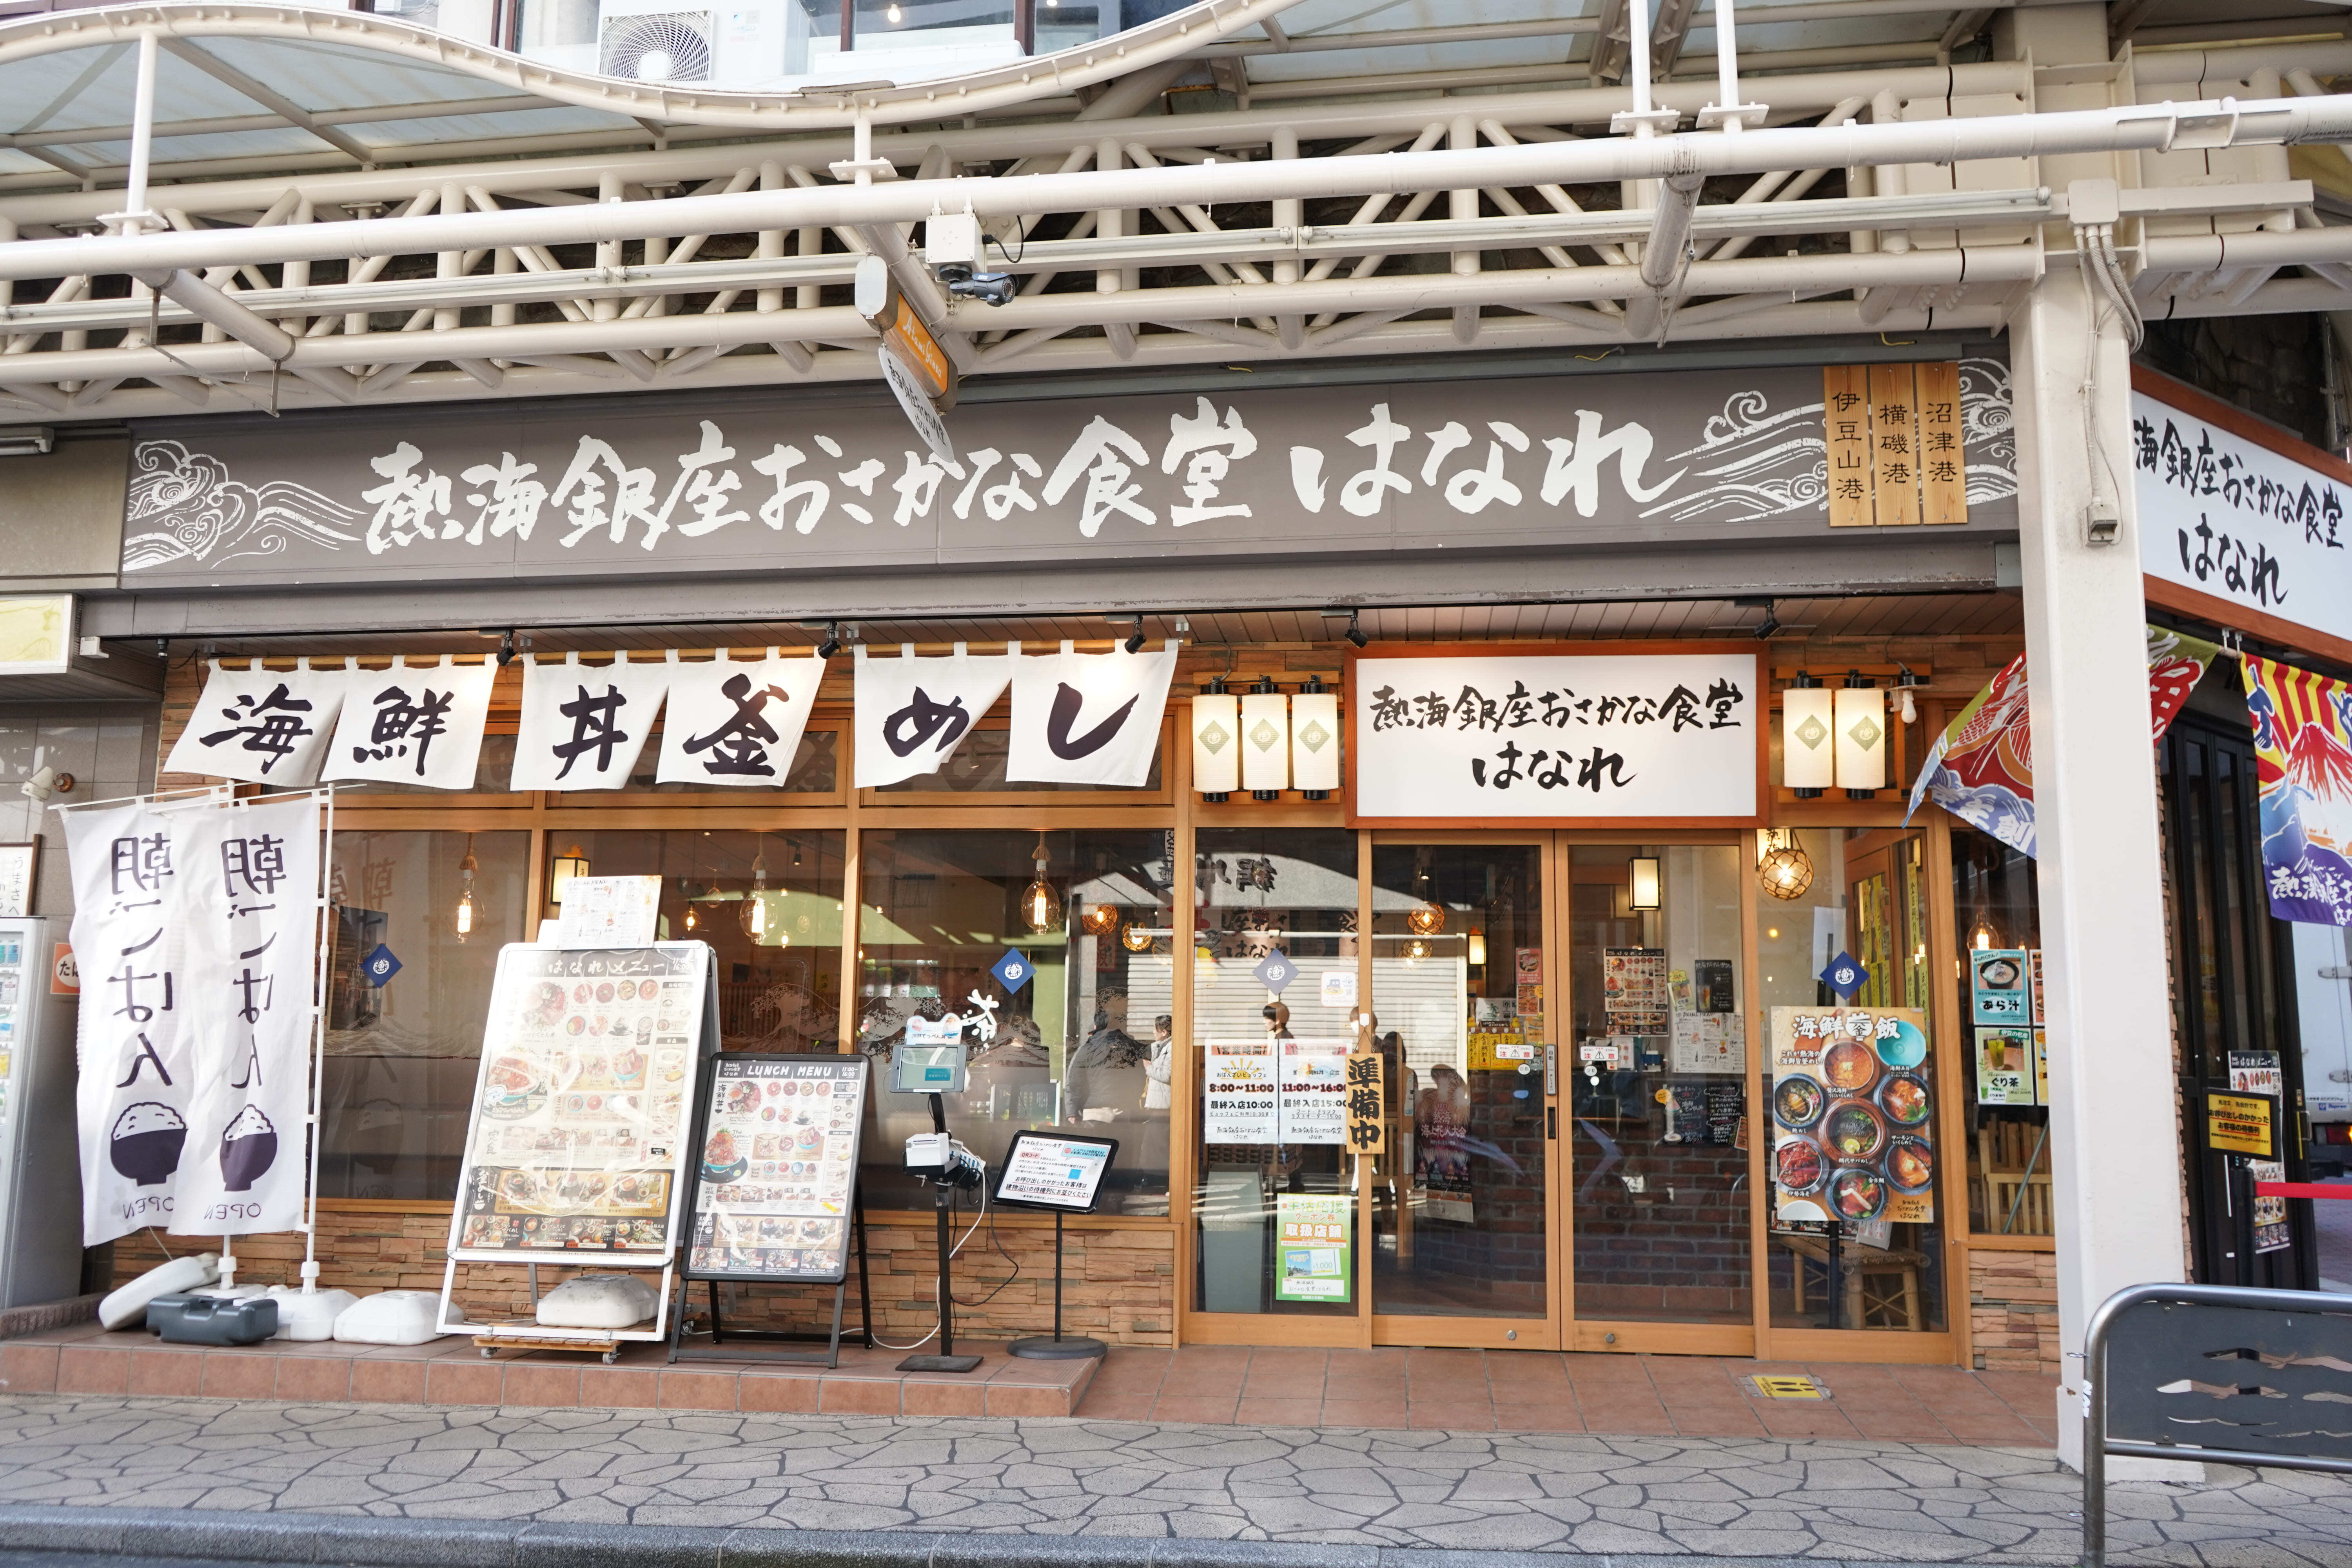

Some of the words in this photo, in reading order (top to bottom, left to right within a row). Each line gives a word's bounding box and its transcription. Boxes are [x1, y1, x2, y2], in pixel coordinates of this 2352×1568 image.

[903, 314, 925, 354] Atami
[926, 340, 942, 378] Ginza
[1832, 392, 1865, 499] 伊豆山港
[1880, 403, 1911, 484] 横磯港
[1926, 402, 1957, 483] 沼津港
[362, 396, 1257, 555] 熱海銀座おさかな食堂
[1290, 403, 1688, 518] はなれ
[2178, 512, 2288, 607] はなれ
[1370, 678, 1743, 733] 熱海銀座おさかな食堂
[1472, 741, 1638, 793] はなれ
[548, 960, 604, 975] はなれ
[612, 960, 665, 974] メニュー
[1983, 1000, 2020, 1011] あら汁
[2001, 1029, 2029, 1039] 伊豆の名産
[1549, 1051, 1553, 1060] 自動
[2240, 1058, 2255, 1066] はなれ
[2257, 1058, 2272, 1066] メニュー
[747, 1065, 790, 1076] LUNCH
[797, 1066, 832, 1076] MENU
[1992, 1077, 2019, 1088] ぐり茶
[716, 1084, 727, 1109] 海鮮丼
[1348, 1057, 1381, 1150] 準備中
[1210, 1101, 1273, 1109] 最終入店10:00
[1433, 1111, 1451, 1124] 熱海
[2209, 1110, 2269, 1123] お呼び出しのかかった
[1421, 1124, 1467, 1138] 海上花火大会
[2218, 1122, 2260, 1133] お客様の待機列
[486, 1129, 499, 1154] 定食
[1006, 1183, 1091, 1198] 建物沿いの待機列にお並びください
[1015, 1177, 1087, 1189] お呼び出しのかかったお客様は
[1285, 1223, 1343, 1238] 取扱店舗
